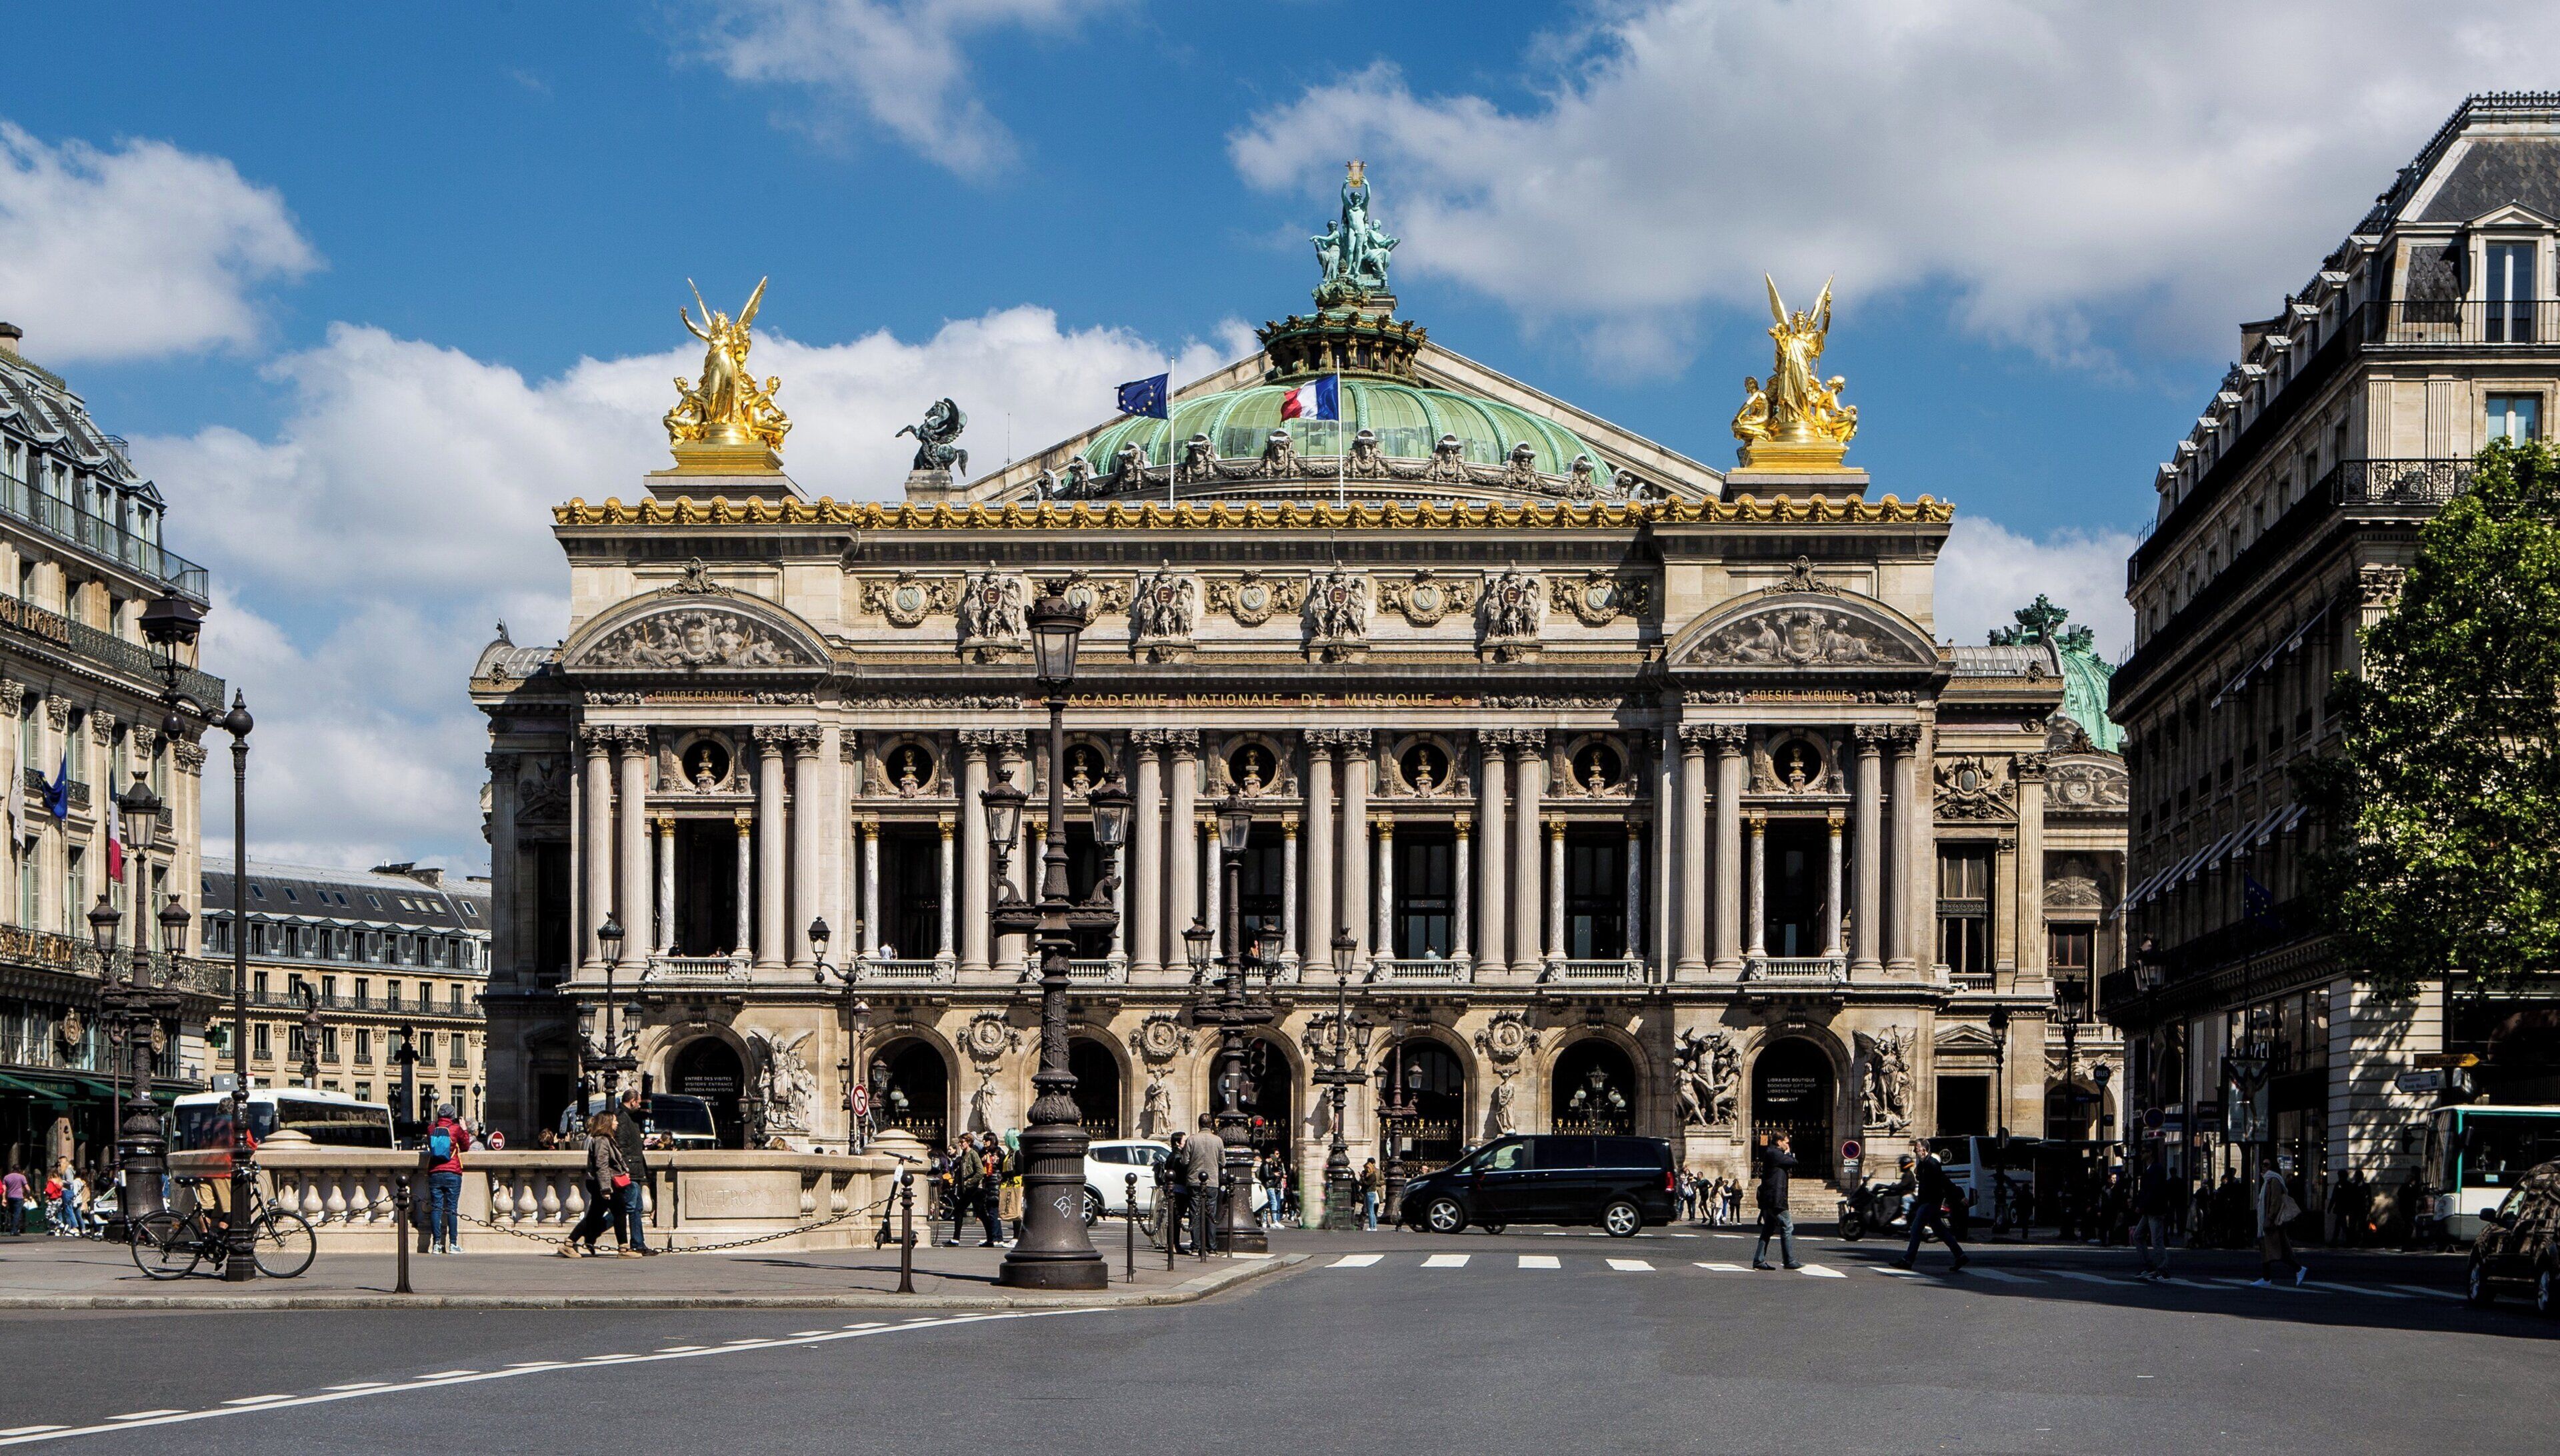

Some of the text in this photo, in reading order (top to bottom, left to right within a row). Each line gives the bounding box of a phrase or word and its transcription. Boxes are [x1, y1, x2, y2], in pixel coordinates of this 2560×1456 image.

[987, 591, 995, 601] E
[1161, 591, 1169, 601] E
[1334, 591, 1341, 601] E
[1508, 591, 1516, 601] E
[655, 690, 744, 701] CHOREGRAPHIE
[1067, 693, 1435, 707] ACADEMIE NATIONALE DE MUSIQUE
[1752, 689, 1849, 703] POESIE LYRIQUE
